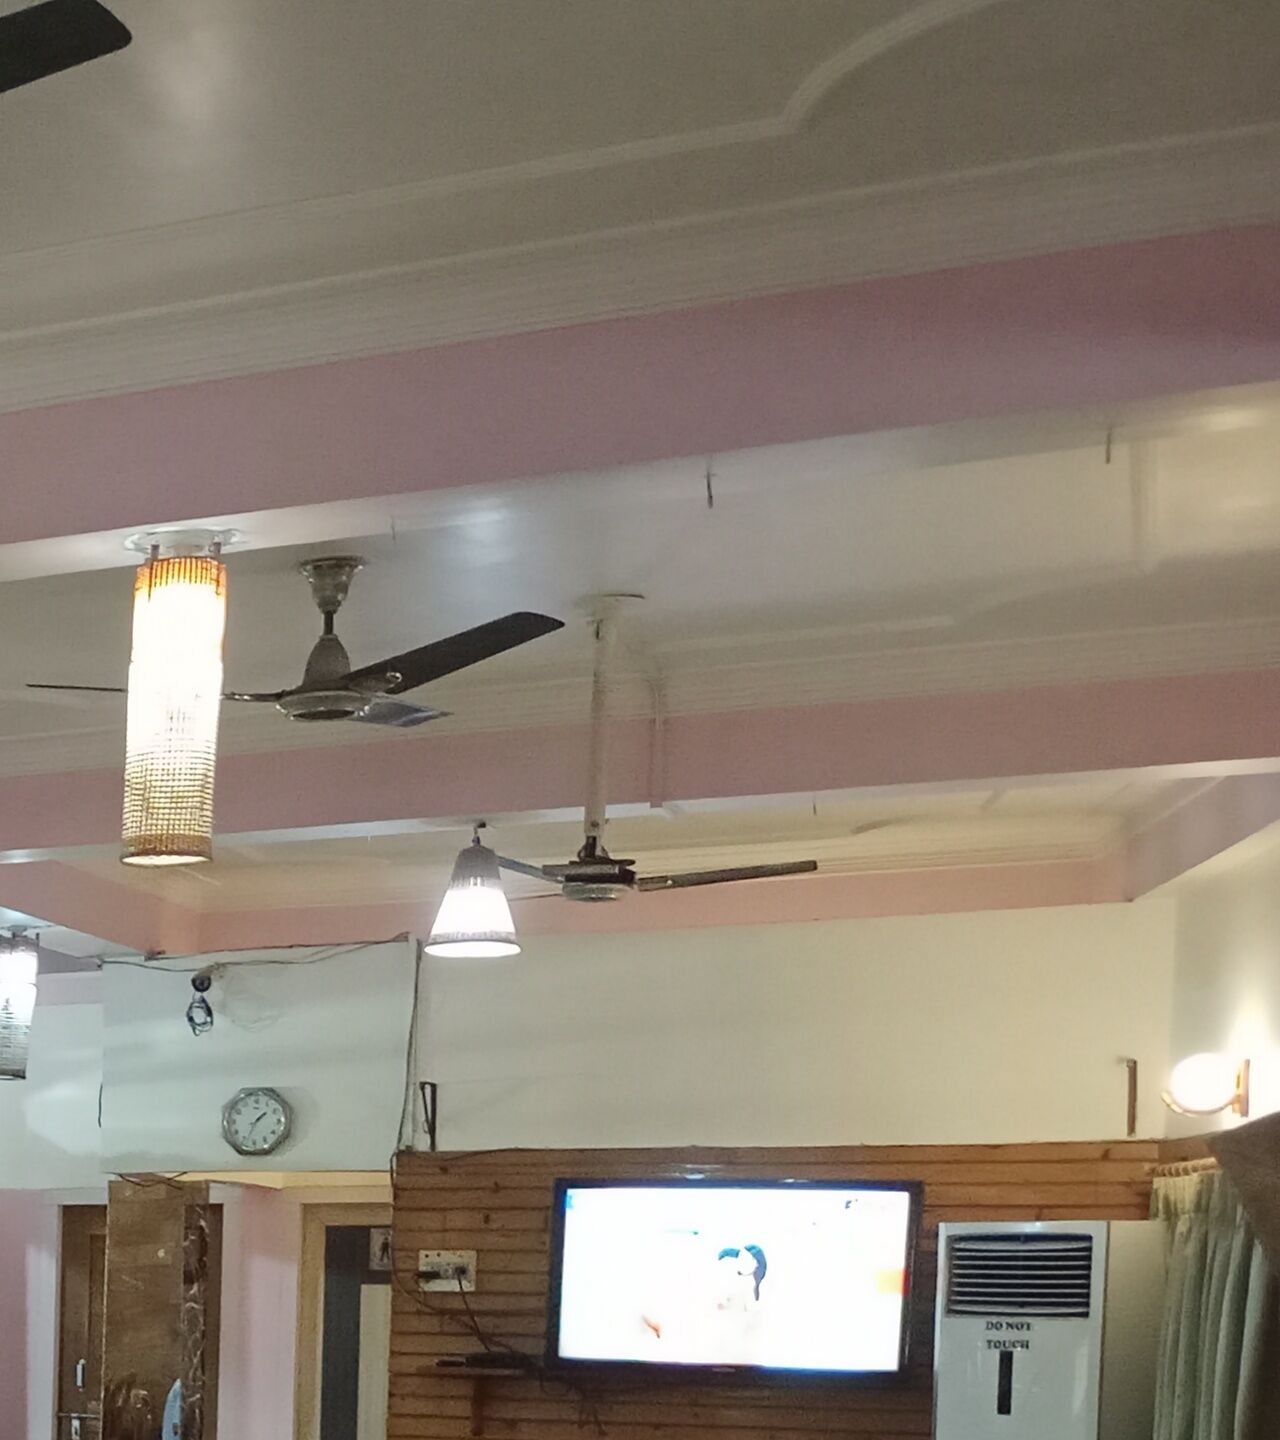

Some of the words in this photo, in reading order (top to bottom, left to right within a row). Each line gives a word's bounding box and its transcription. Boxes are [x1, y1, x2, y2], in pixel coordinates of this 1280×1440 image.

[986, 1321, 1003, 1331] DO
[1005, 1321, 1031, 1331] NOT
[986, 1339, 1029, 1349] TOUCH
